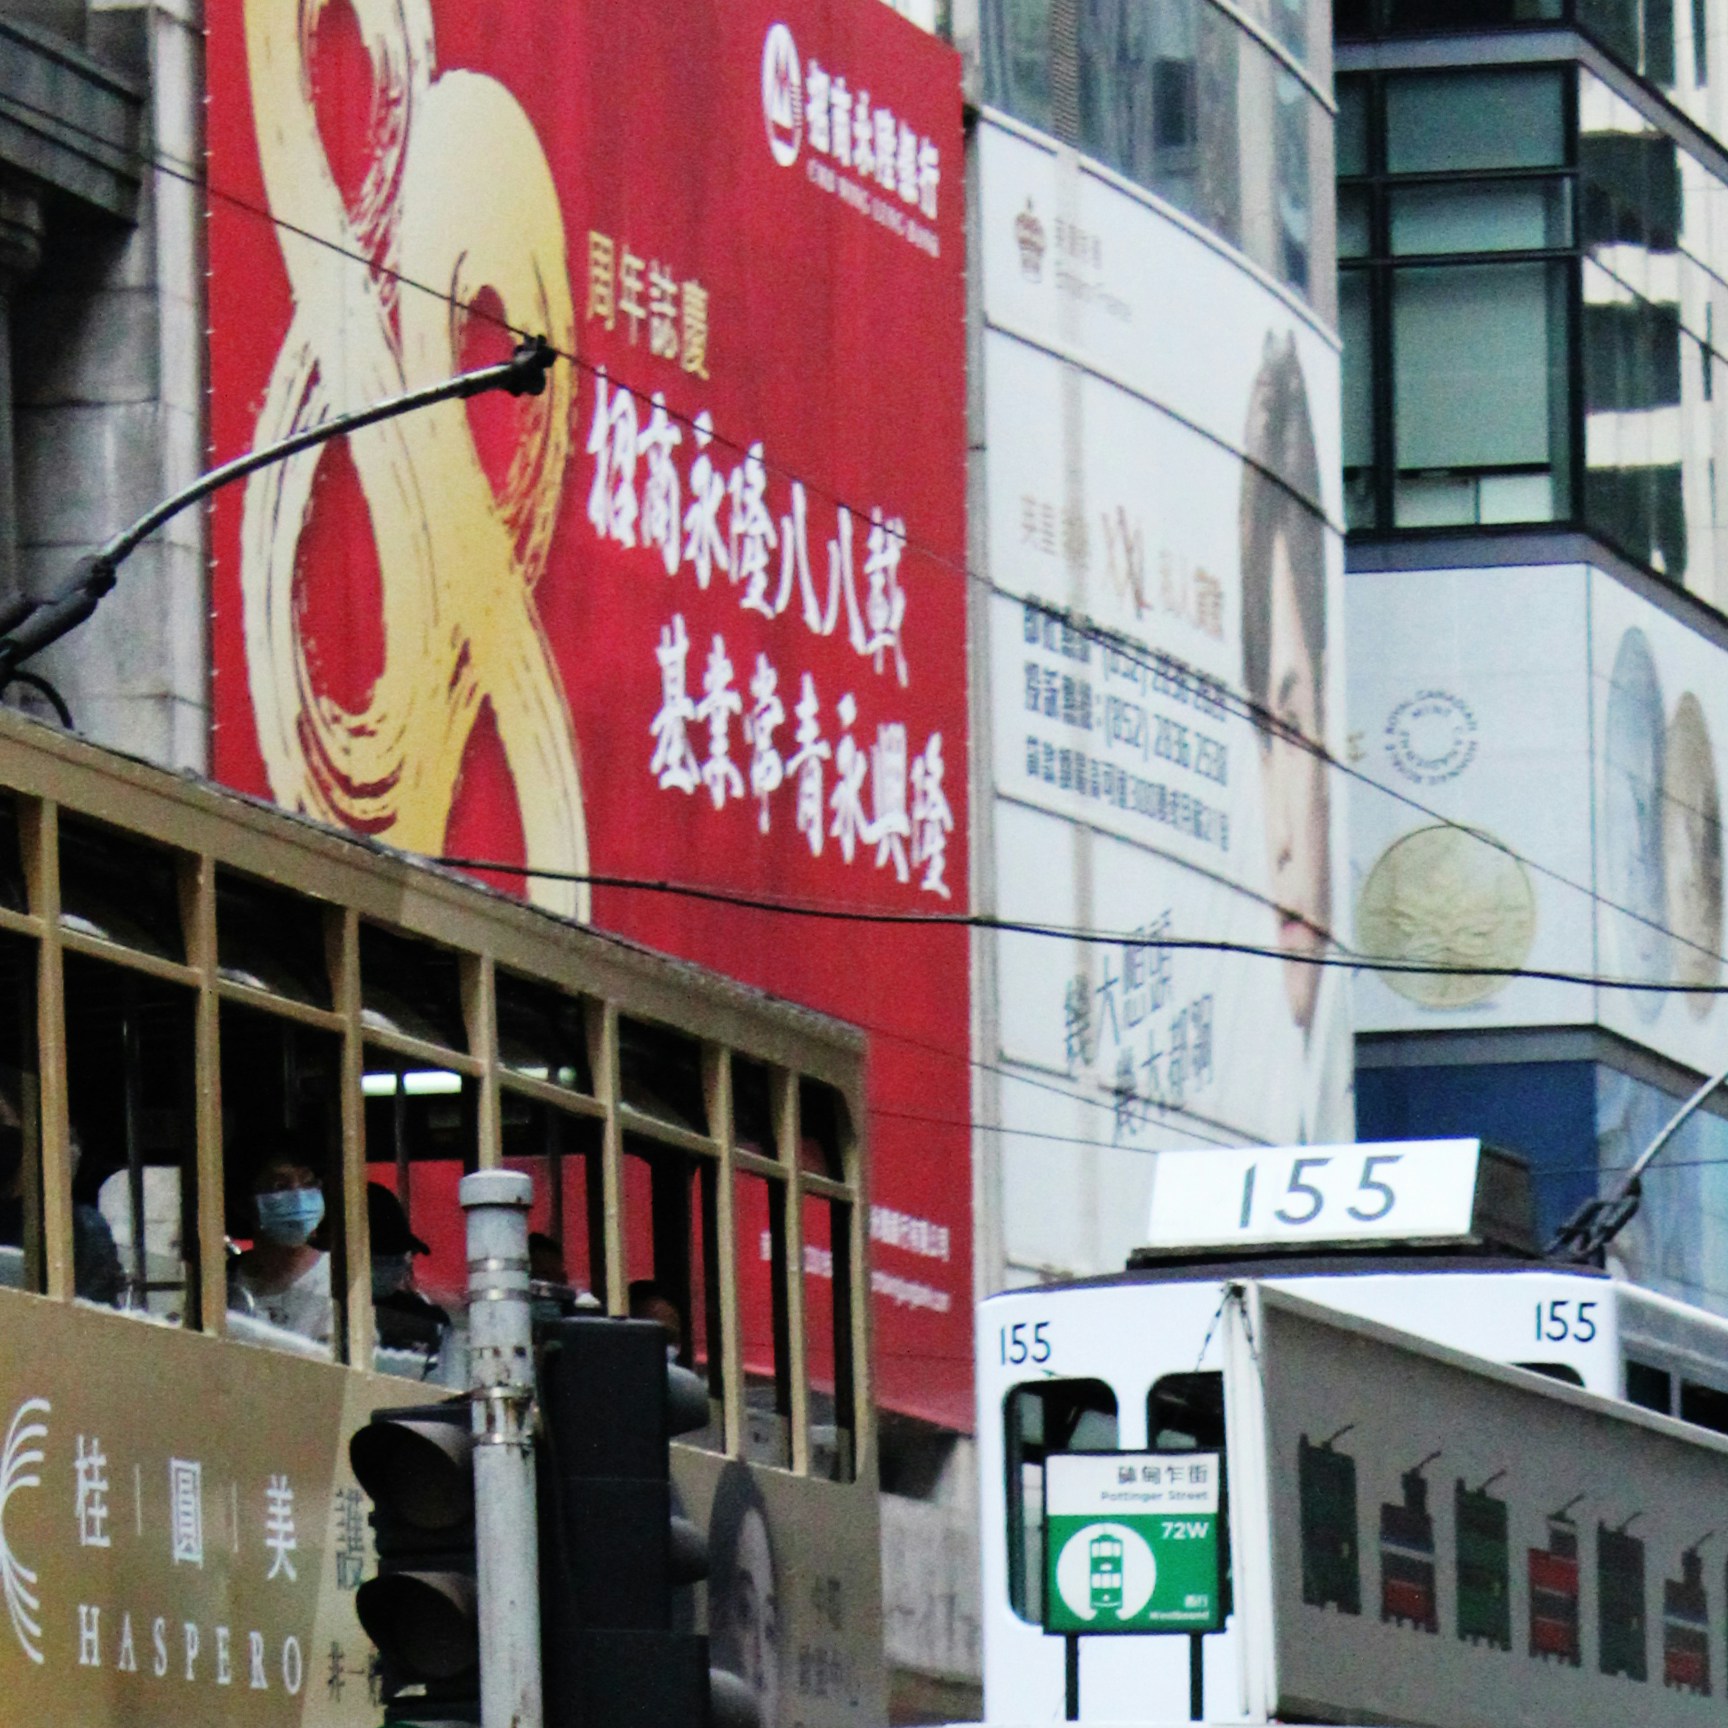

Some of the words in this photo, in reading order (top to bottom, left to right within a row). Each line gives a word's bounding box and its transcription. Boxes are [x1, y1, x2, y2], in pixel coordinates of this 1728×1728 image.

[1238, 1154, 1404, 1229] 155
[1000, 1321, 1052, 1366] 155
[1535, 1300, 1598, 1343] 155
[1168, 1490, 1209, 1501] Street
[1161, 1521, 1209, 1540] 72W
[77, 1603, 302, 1695] HASPERO
